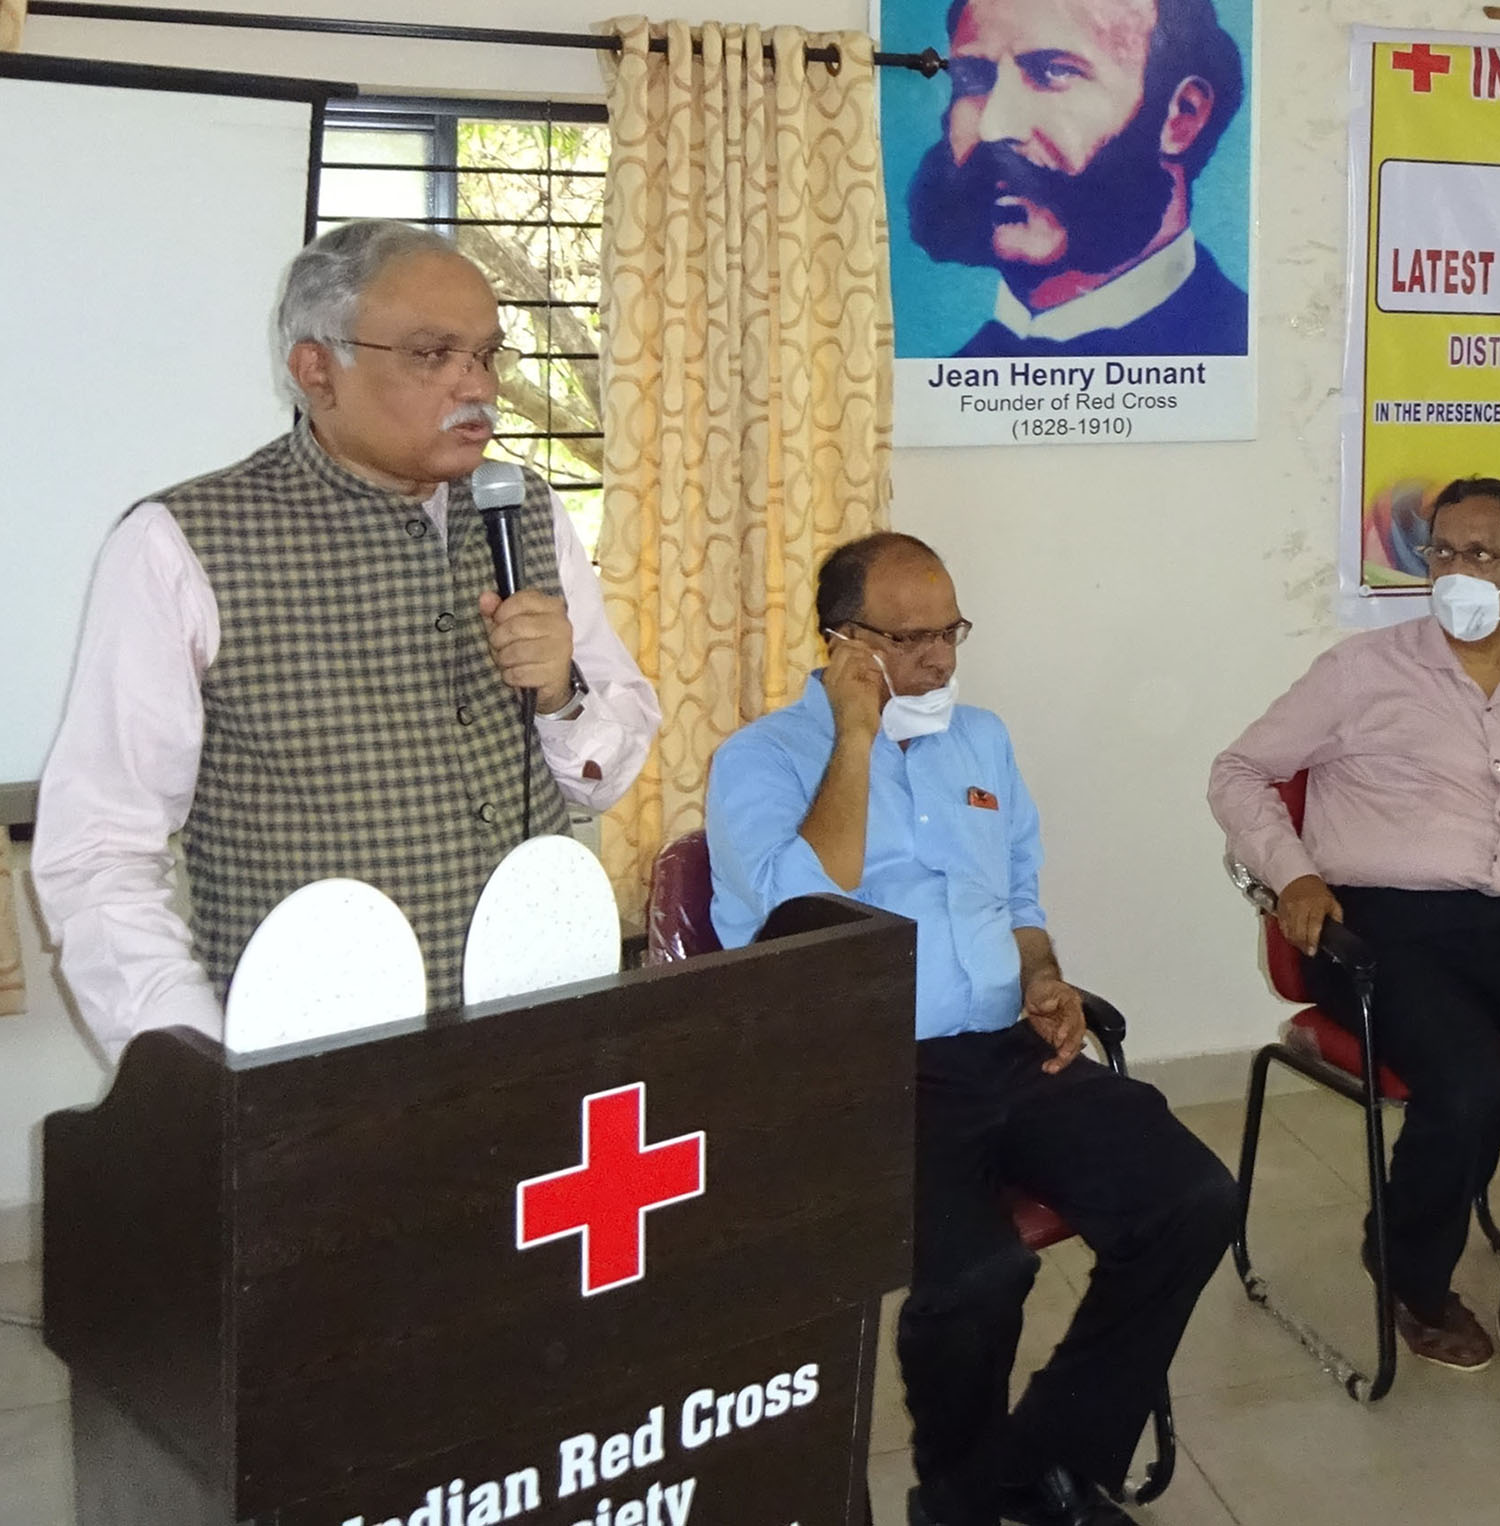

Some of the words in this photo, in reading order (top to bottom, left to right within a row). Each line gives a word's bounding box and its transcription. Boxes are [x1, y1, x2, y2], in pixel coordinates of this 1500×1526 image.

[1392, 248, 1495, 295] LATEST
[928, 364, 999, 388] Jean
[1010, 362, 1096, 391] Henry
[1105, 361, 1207, 386] Dunant
[960, 394, 1044, 412] Founder
[1050, 393, 1070, 411] of
[1076, 393, 1115, 410] Red
[1122, 391, 1177, 410] Cross
[1375, 403, 1389, 422] IN
[1394, 403, 1421, 422] THE
[1427, 403, 1500, 423] PRESENCE
[1011, 416, 1132, 440] (1828-1910)
[341, 1466, 542, 1526] dian
[557, 1405, 666, 1498] Red
[679, 1362, 821, 1450] Cross
